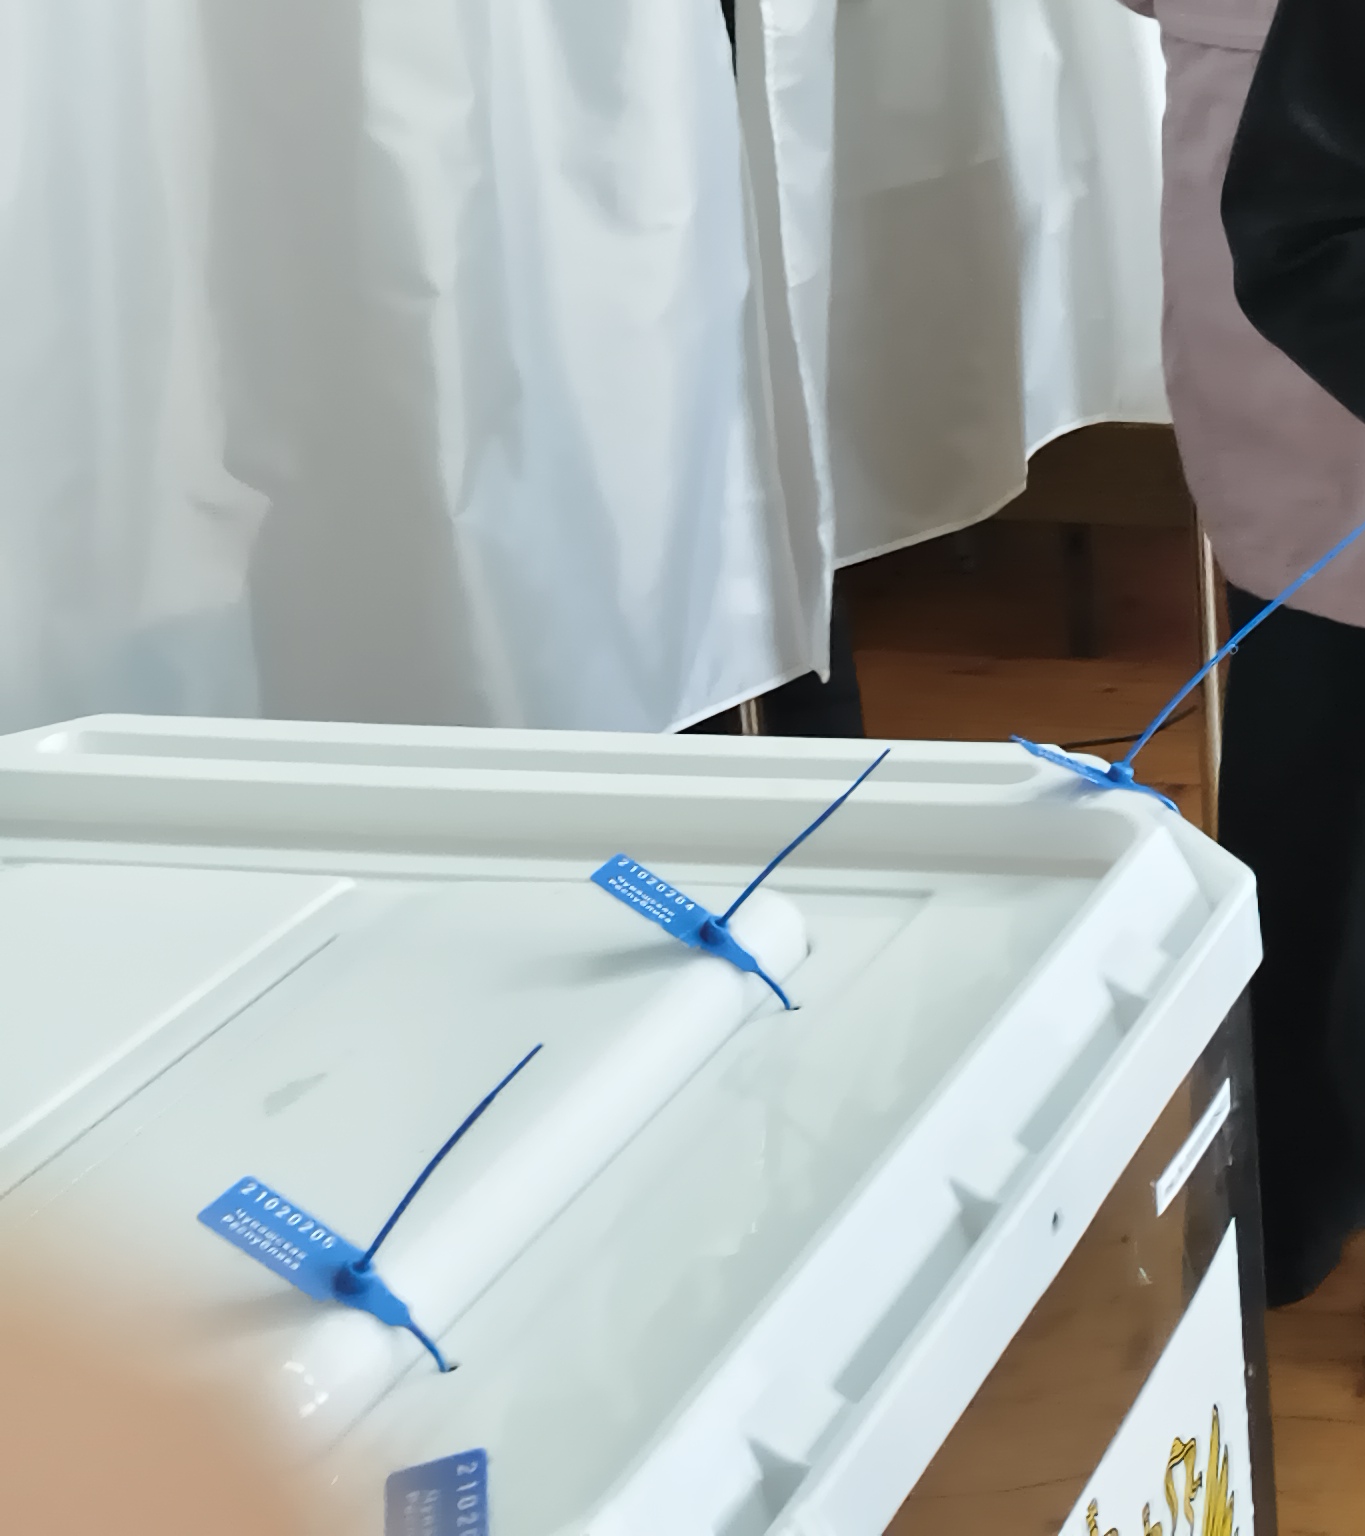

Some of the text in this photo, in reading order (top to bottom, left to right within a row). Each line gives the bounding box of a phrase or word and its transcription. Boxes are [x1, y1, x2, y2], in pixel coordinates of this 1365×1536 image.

[608, 877, 672, 924] Республика
[616, 875, 675, 917] Чувашская
[617, 858, 695, 912] 21020204
[221, 1213, 301, 1271] Республика
[234, 1207, 308, 1260] Чувашская
